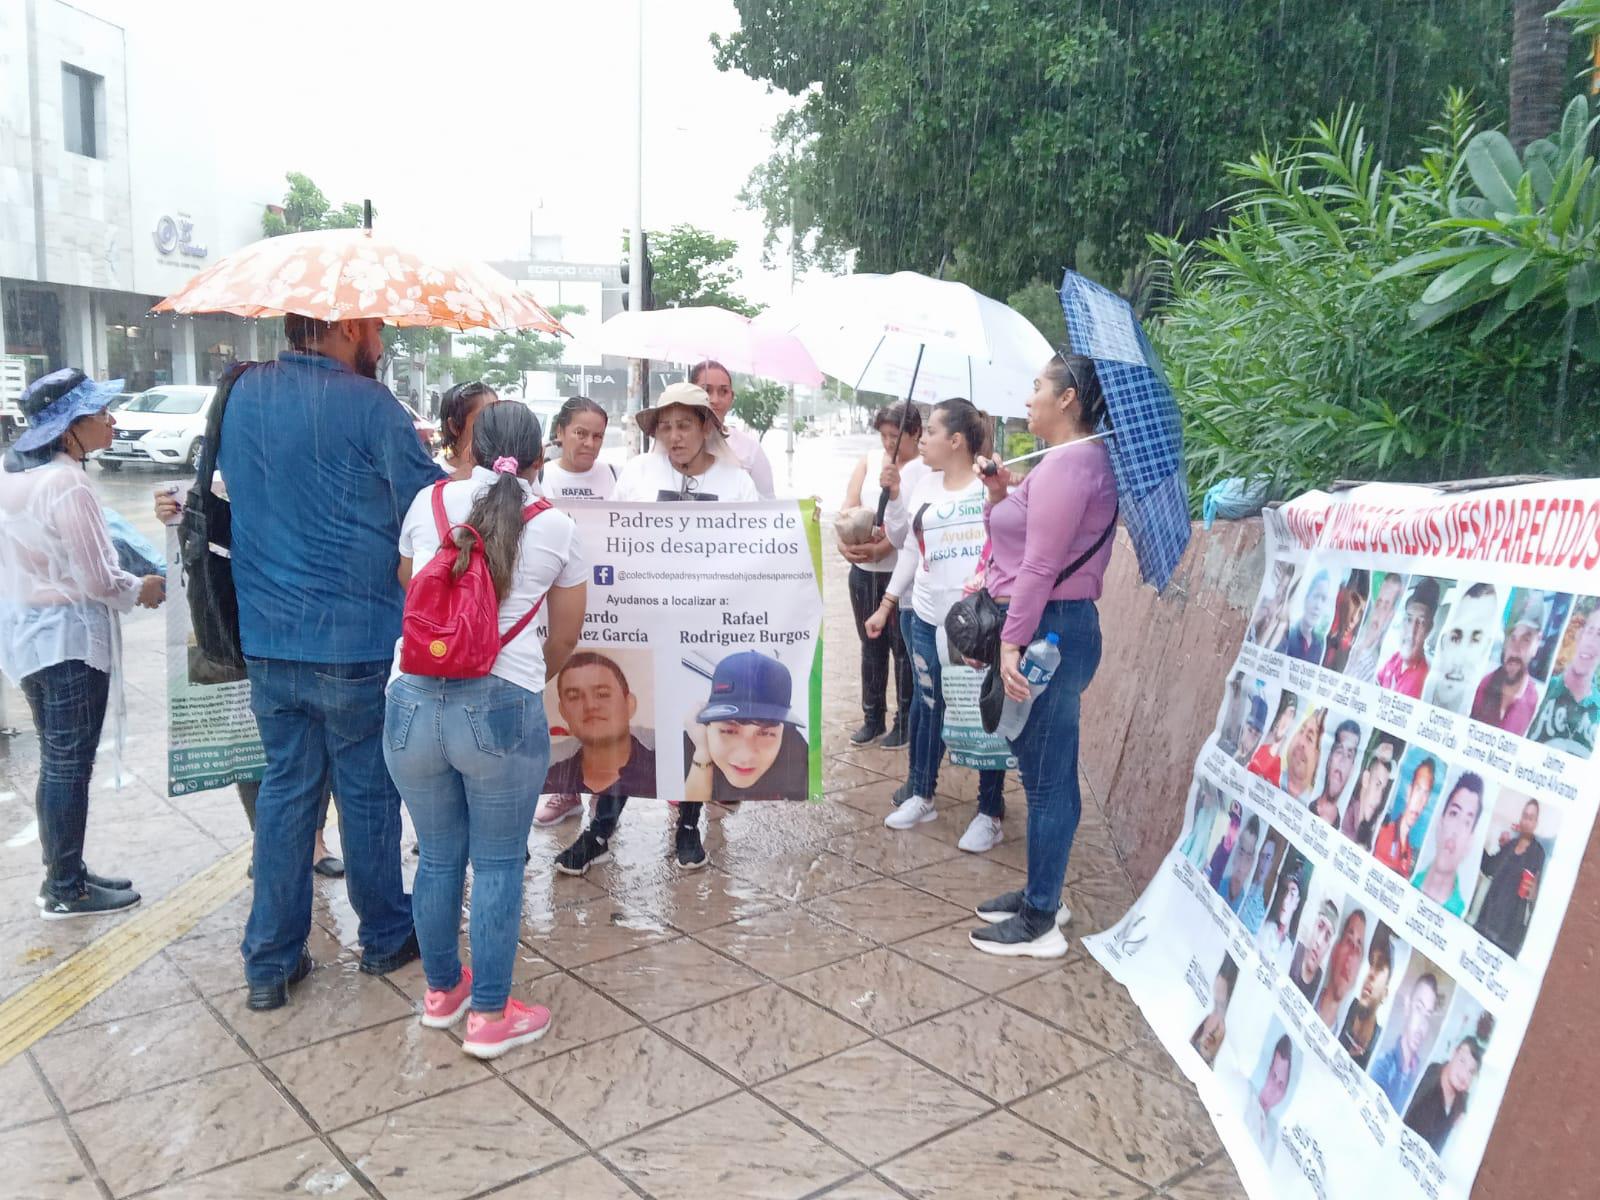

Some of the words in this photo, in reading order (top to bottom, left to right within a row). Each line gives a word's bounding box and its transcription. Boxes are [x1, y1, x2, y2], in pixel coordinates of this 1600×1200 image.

[561, 488, 595, 497] RAFAEL
[608, 511, 674, 529] Padres
[678, 515, 691, 533] y
[696, 512, 767, 530] madres
[773, 512, 797, 530] de
[606, 537, 655, 557] Hijos
[660, 537, 799, 558] desaparecidos
[662, 597, 669, 606] a
[671, 595, 716, 606] localizar
[719, 597, 729, 606] a:
[722, 611, 769, 625] Rafael
[602, 628, 648, 643] García
[680, 630, 755, 646] Rodriguez
[759, 629, 810, 645] Burgos
